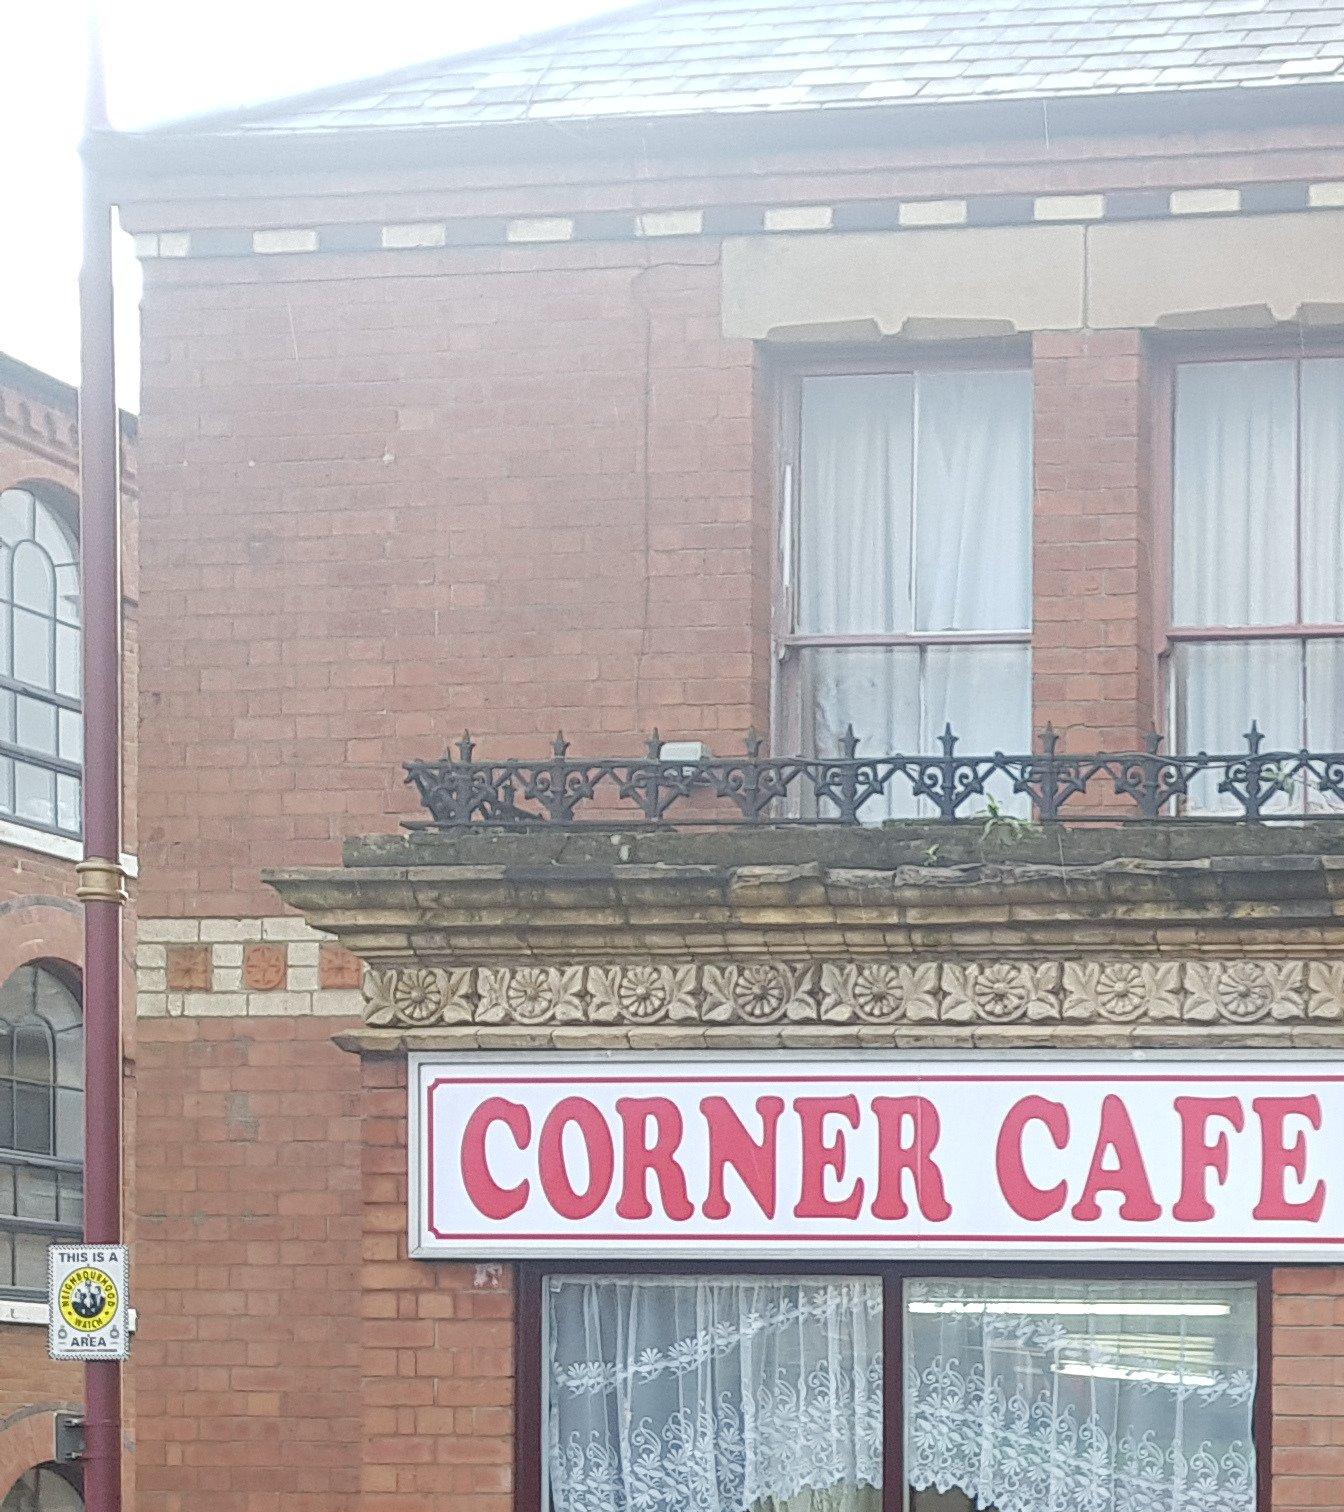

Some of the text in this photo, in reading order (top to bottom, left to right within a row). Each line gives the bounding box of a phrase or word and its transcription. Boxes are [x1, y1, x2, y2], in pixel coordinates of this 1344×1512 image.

[459, 1092, 1327, 1223] CORNER CAFE
[59, 1252, 119, 1263] THIS IS A
[74, 1317, 103, 1329] WATCH
[71, 1336, 107, 1347] AREA
